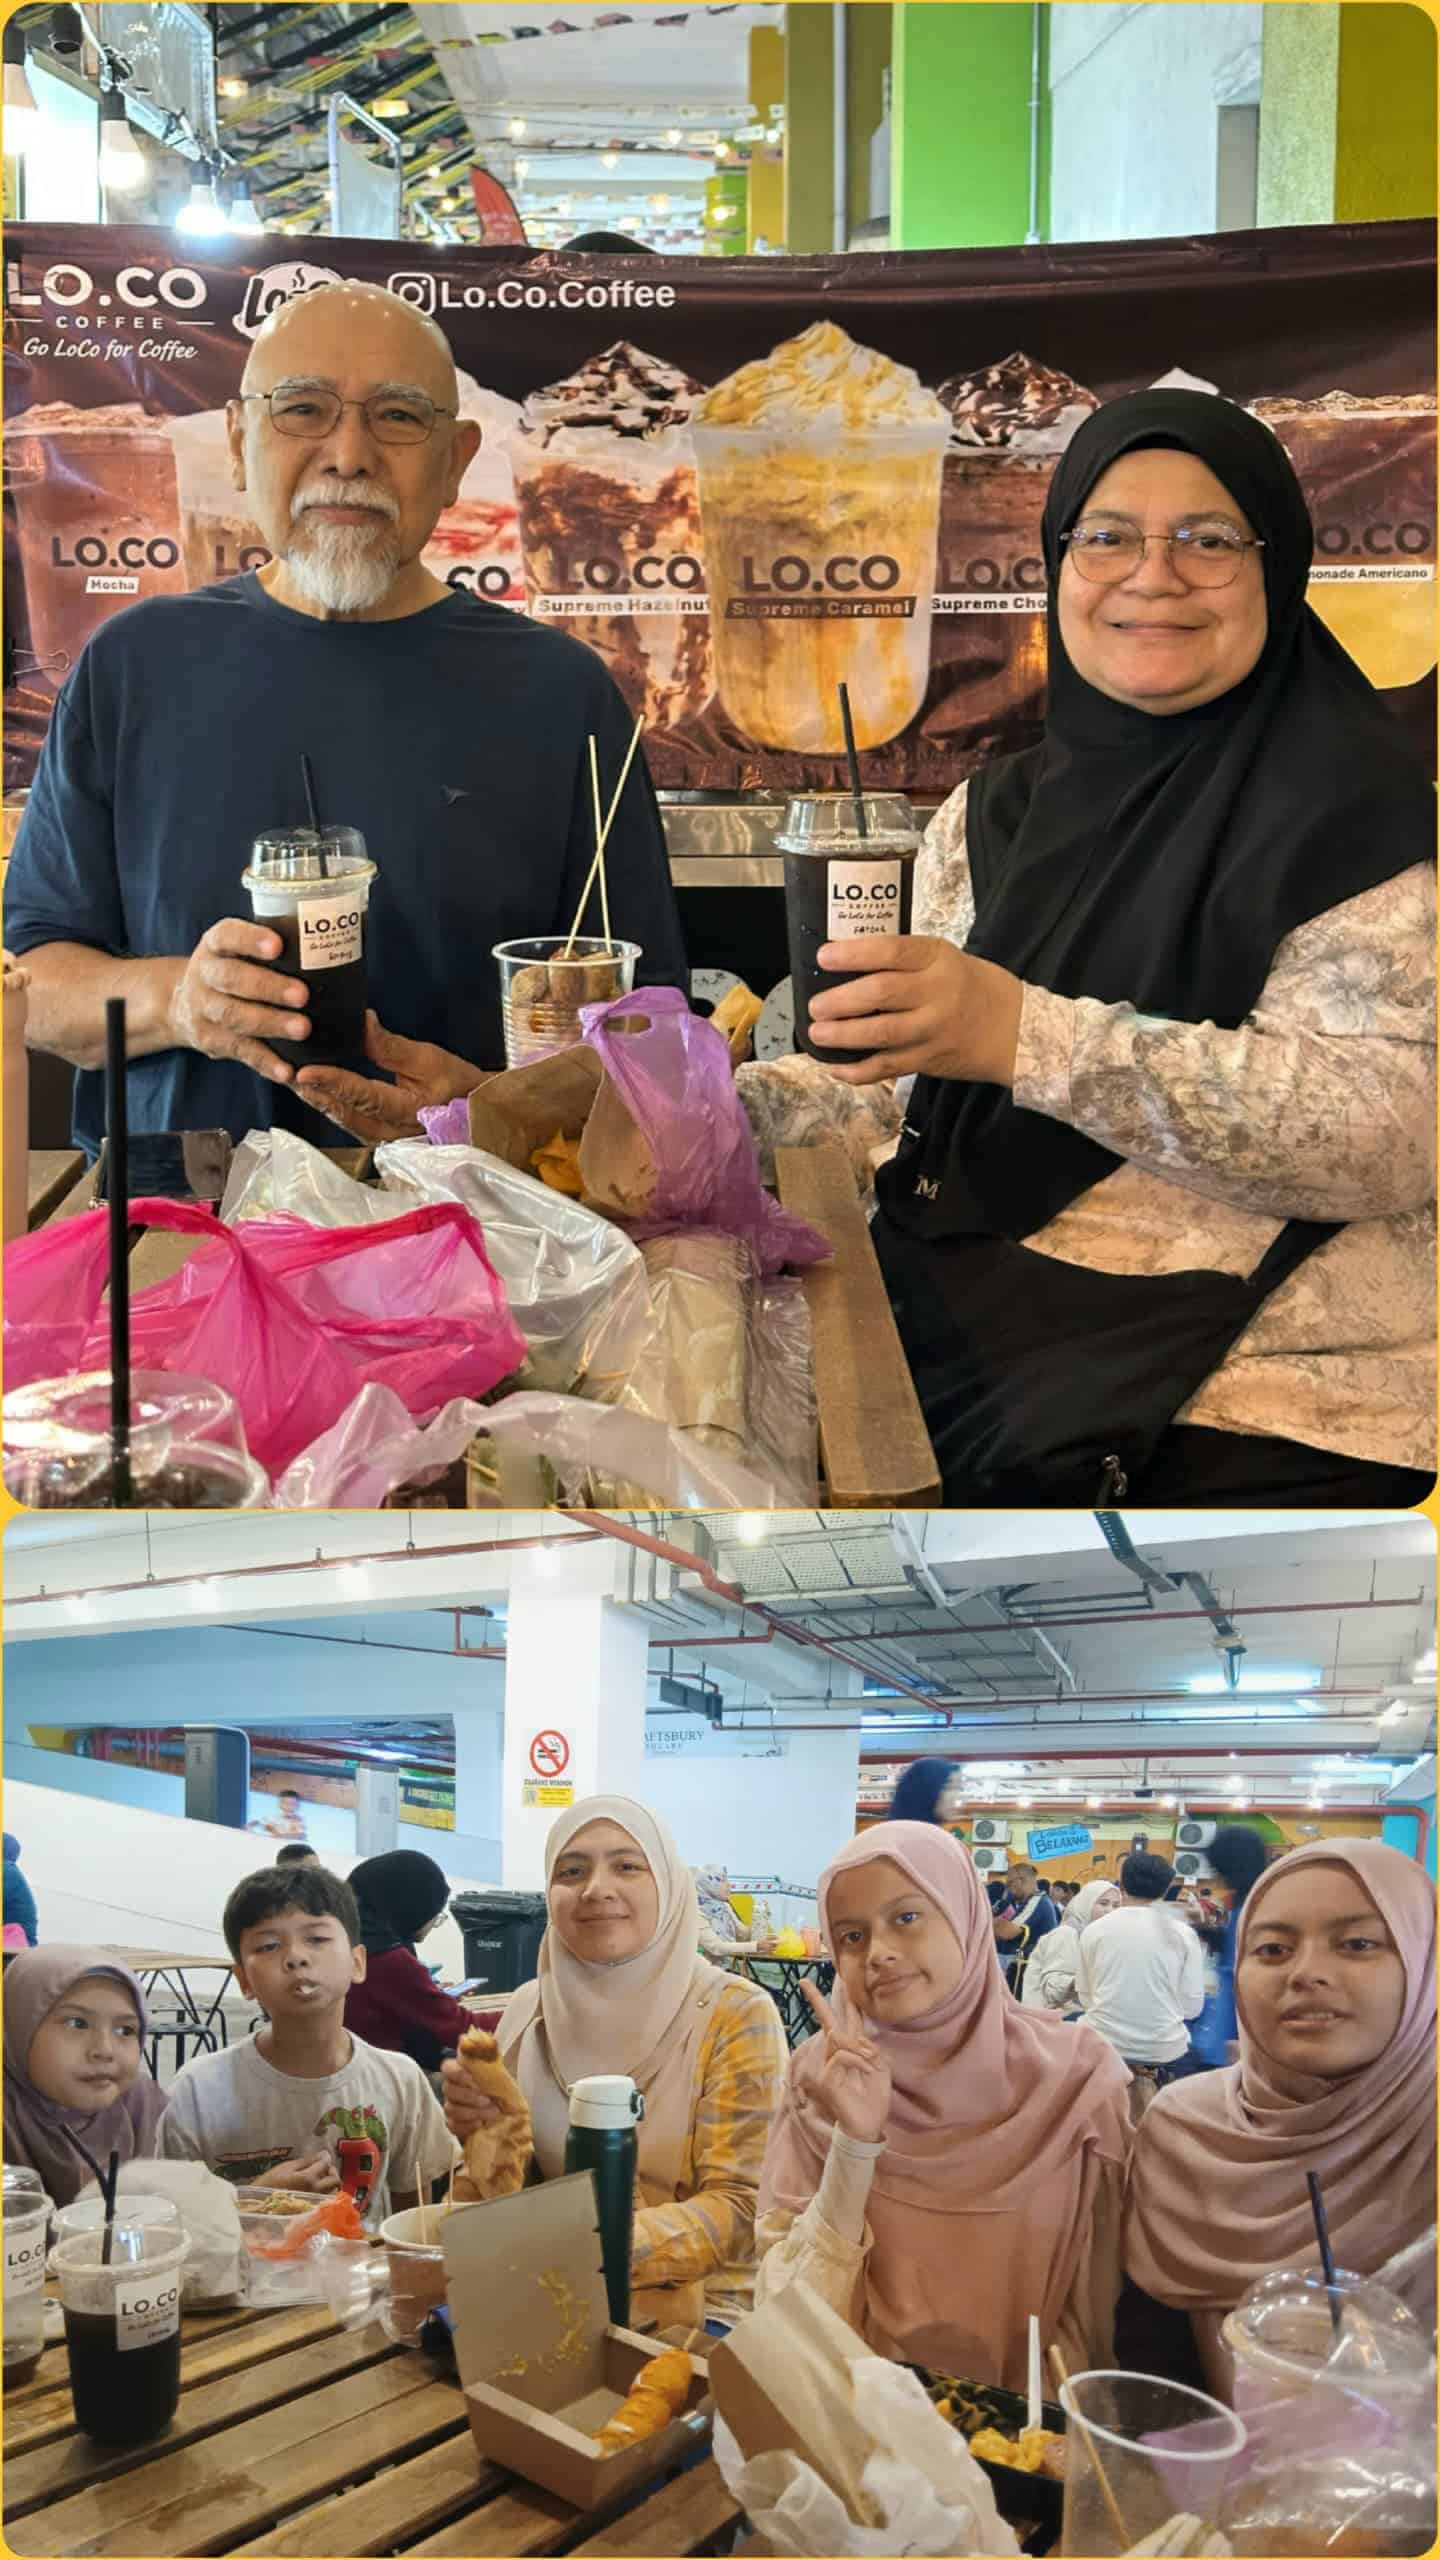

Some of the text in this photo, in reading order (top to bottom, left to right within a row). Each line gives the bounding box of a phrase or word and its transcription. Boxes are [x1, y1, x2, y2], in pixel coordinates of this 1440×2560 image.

[7, 263, 207, 308] LO.CO
[441, 280, 676, 309] Lo.Co.Coffee
[56, 316, 163, 329] COFFEE
[24, 337, 198, 361] Go LoCo for Coffee
[1316, 521, 1431, 555] O.CO
[52, 537, 179, 568] LO.CO
[215, 545, 273, 576] LO
[91, 579, 135, 591] Mocha
[743, 555, 900, 592] LO.CO
[942, 557, 1044, 590] LO.C
[1359, 568, 1428, 578] Americano
[538, 598, 624, 614] Supreme
[731, 600, 911, 618] Supreme Caramel
[931, 597, 1047, 612] Supreme Cho
[833, 883, 897, 900] LO.CO
[304, 912, 359, 934] LO.CO
[8, 2243, 43, 2267] LO.C
[122, 2288, 177, 2316] LO.CO
